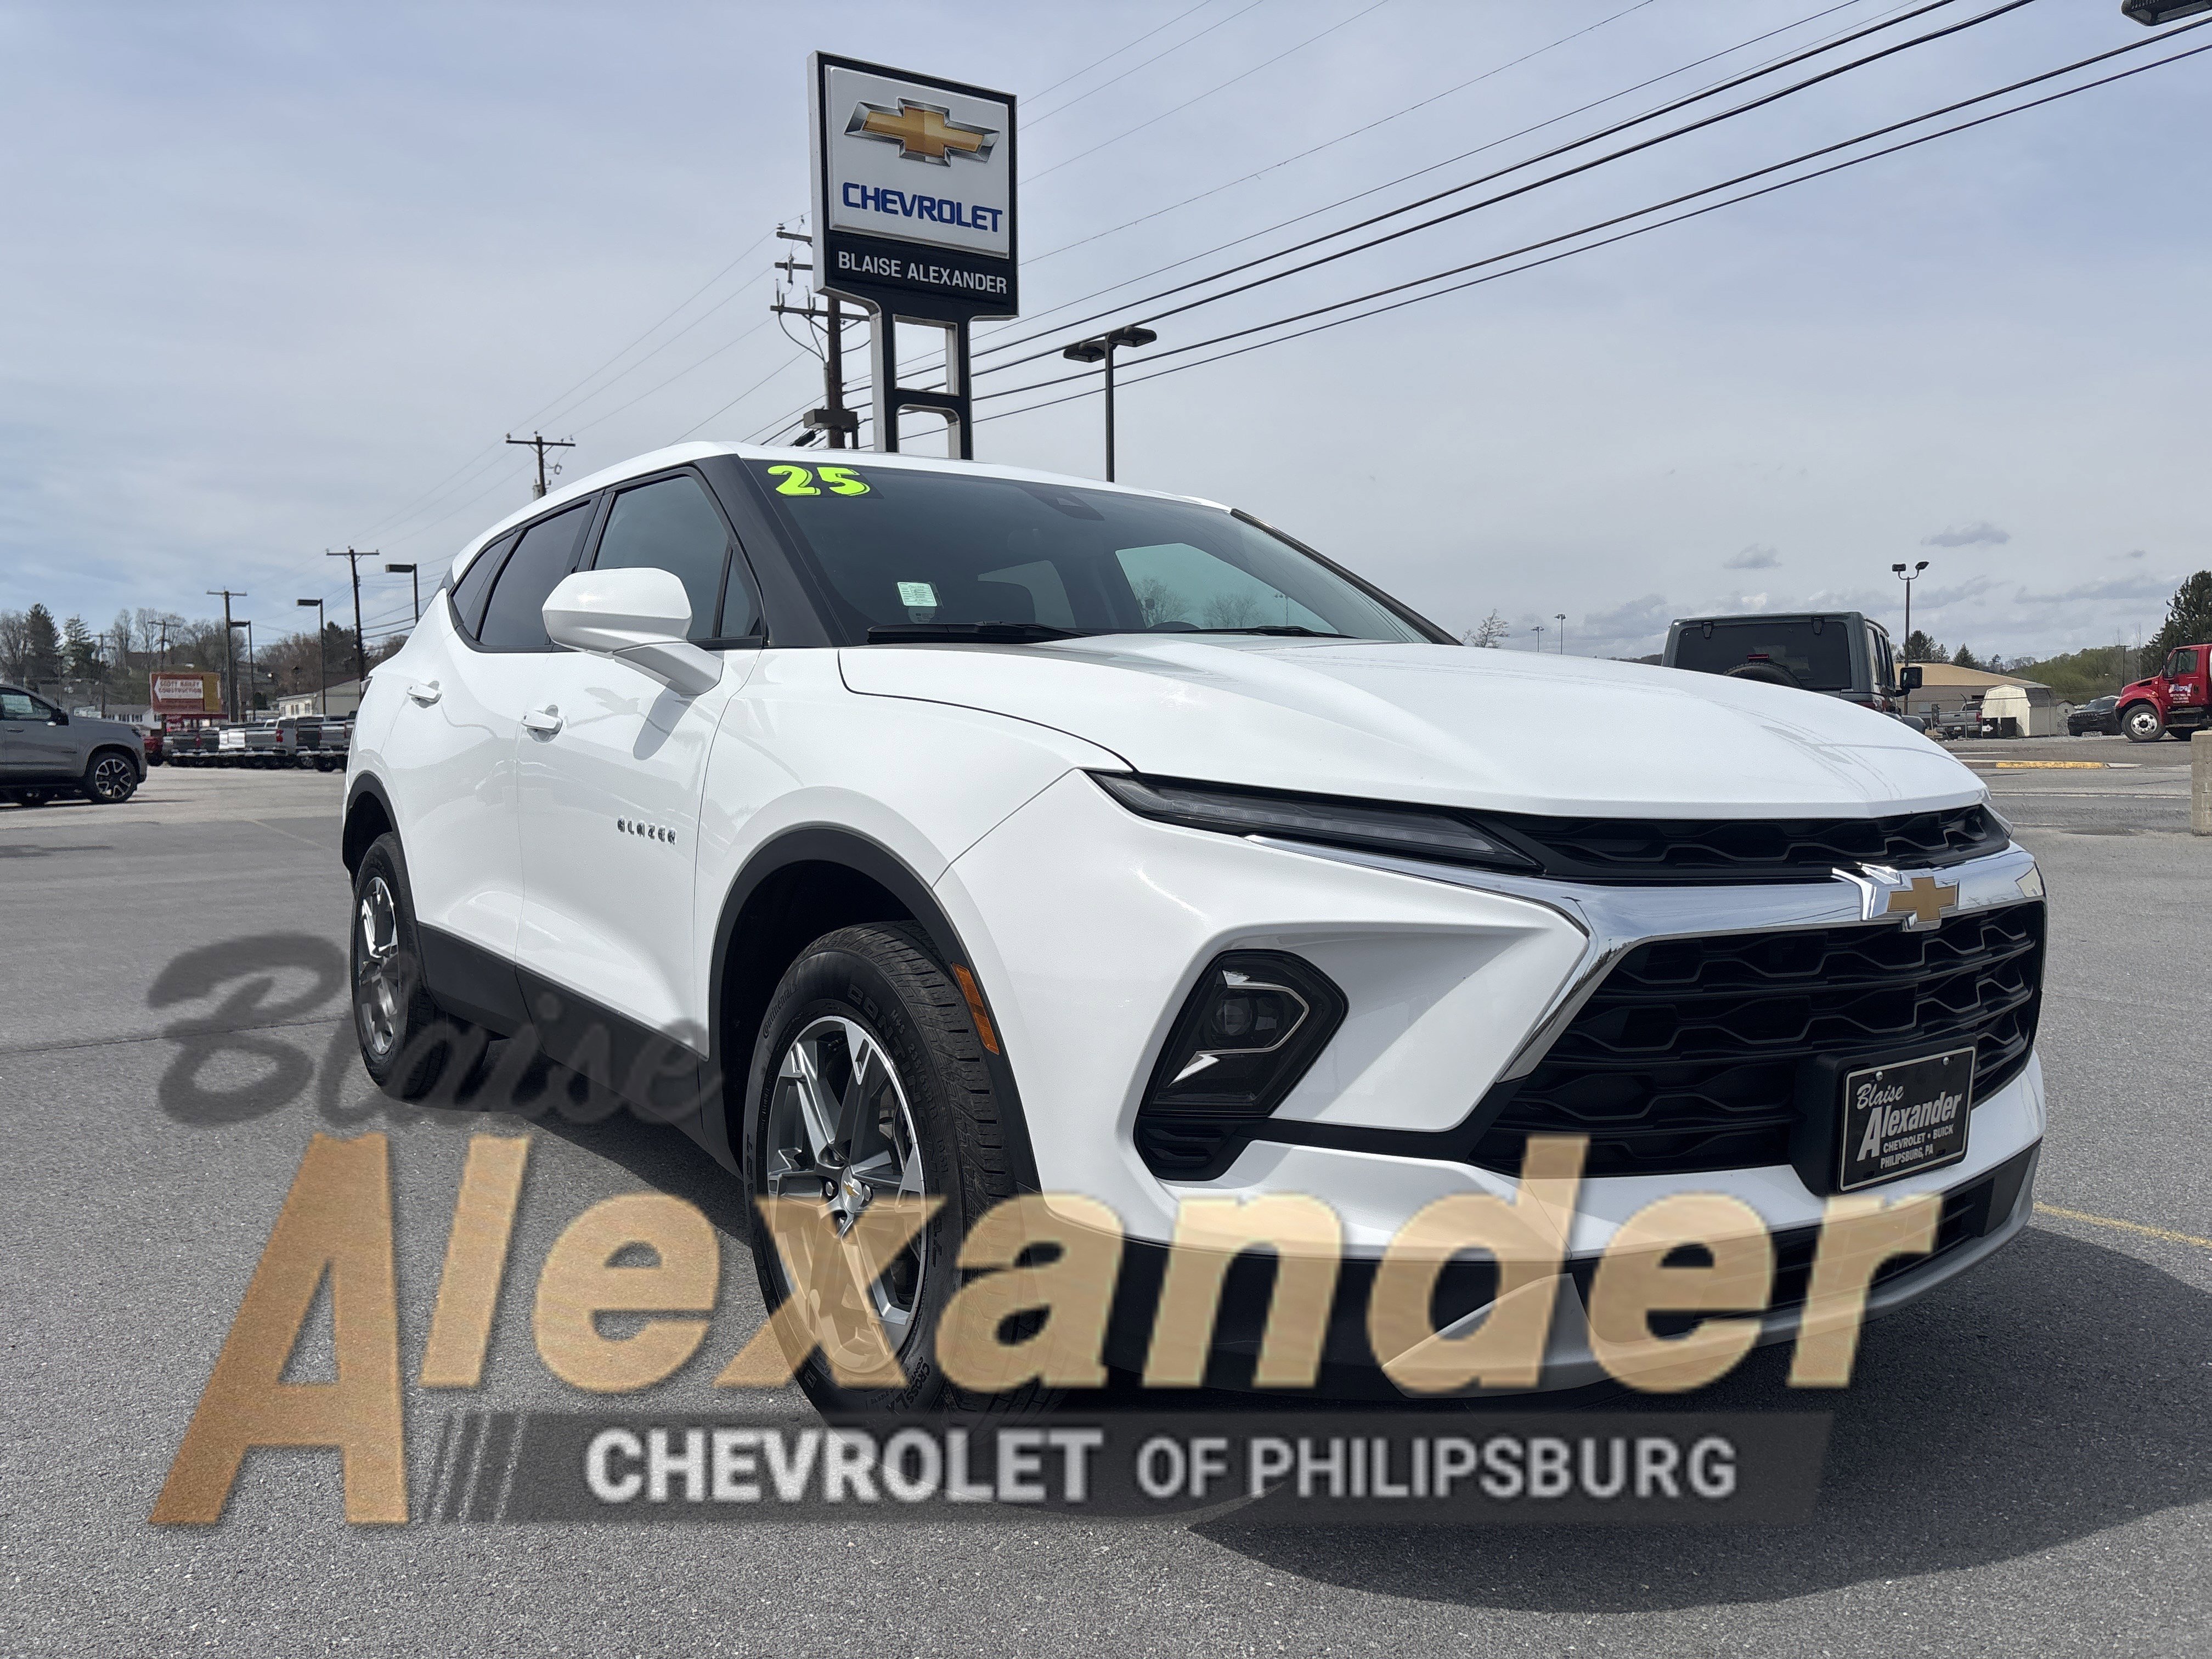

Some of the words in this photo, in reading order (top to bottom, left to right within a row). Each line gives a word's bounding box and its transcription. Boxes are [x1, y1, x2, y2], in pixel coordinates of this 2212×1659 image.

[843, 182, 1002, 233] CHEVROLET
[838, 251, 901, 278] BLAISE
[907, 262, 1007, 295] ALEXANDER
[767, 465, 871, 496] 25
[617, 817, 676, 845] BLAZER
[1856, 1083, 1905, 1110] Blaise
[1856, 1091, 1963, 1162] Alexander
[1883, 1132, 1926, 1154] CHEVROLET
[1932, 1124, 1954, 1140] BUICK
[1925, 1144, 1934, 1157] PA
